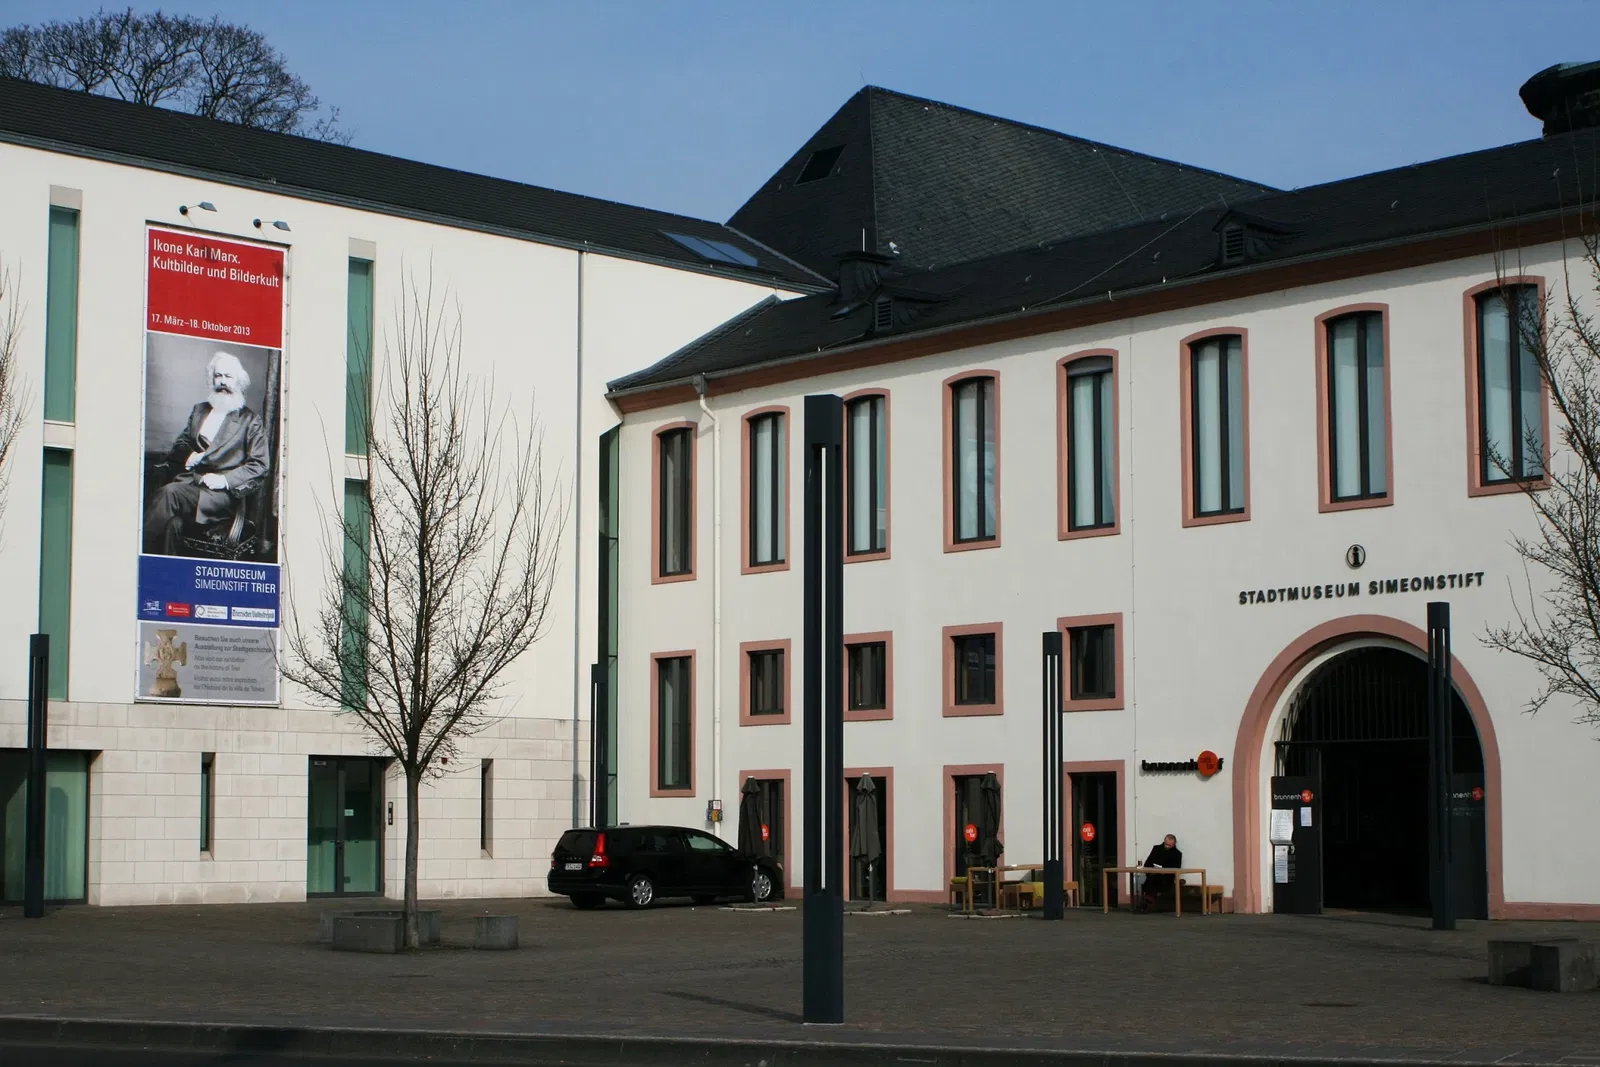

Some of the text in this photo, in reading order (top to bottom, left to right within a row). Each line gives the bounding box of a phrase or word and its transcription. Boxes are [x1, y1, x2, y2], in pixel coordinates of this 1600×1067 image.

[153, 238, 241, 264] Ikone Karl Marx.
[153, 256, 279, 288] Kultbilder und Bilderkult
[151, 313, 162, 324] 17.
[202, 320, 231, 333] Oktober
[233, 325, 250, 336] 2013
[195, 565, 266, 580] STADTMUSEUM
[195, 578, 276, 594] SIMEONSTIFT TRIER
[1239, 572, 1485, 605] STADTMUSEUM SIMEONSTIFT
